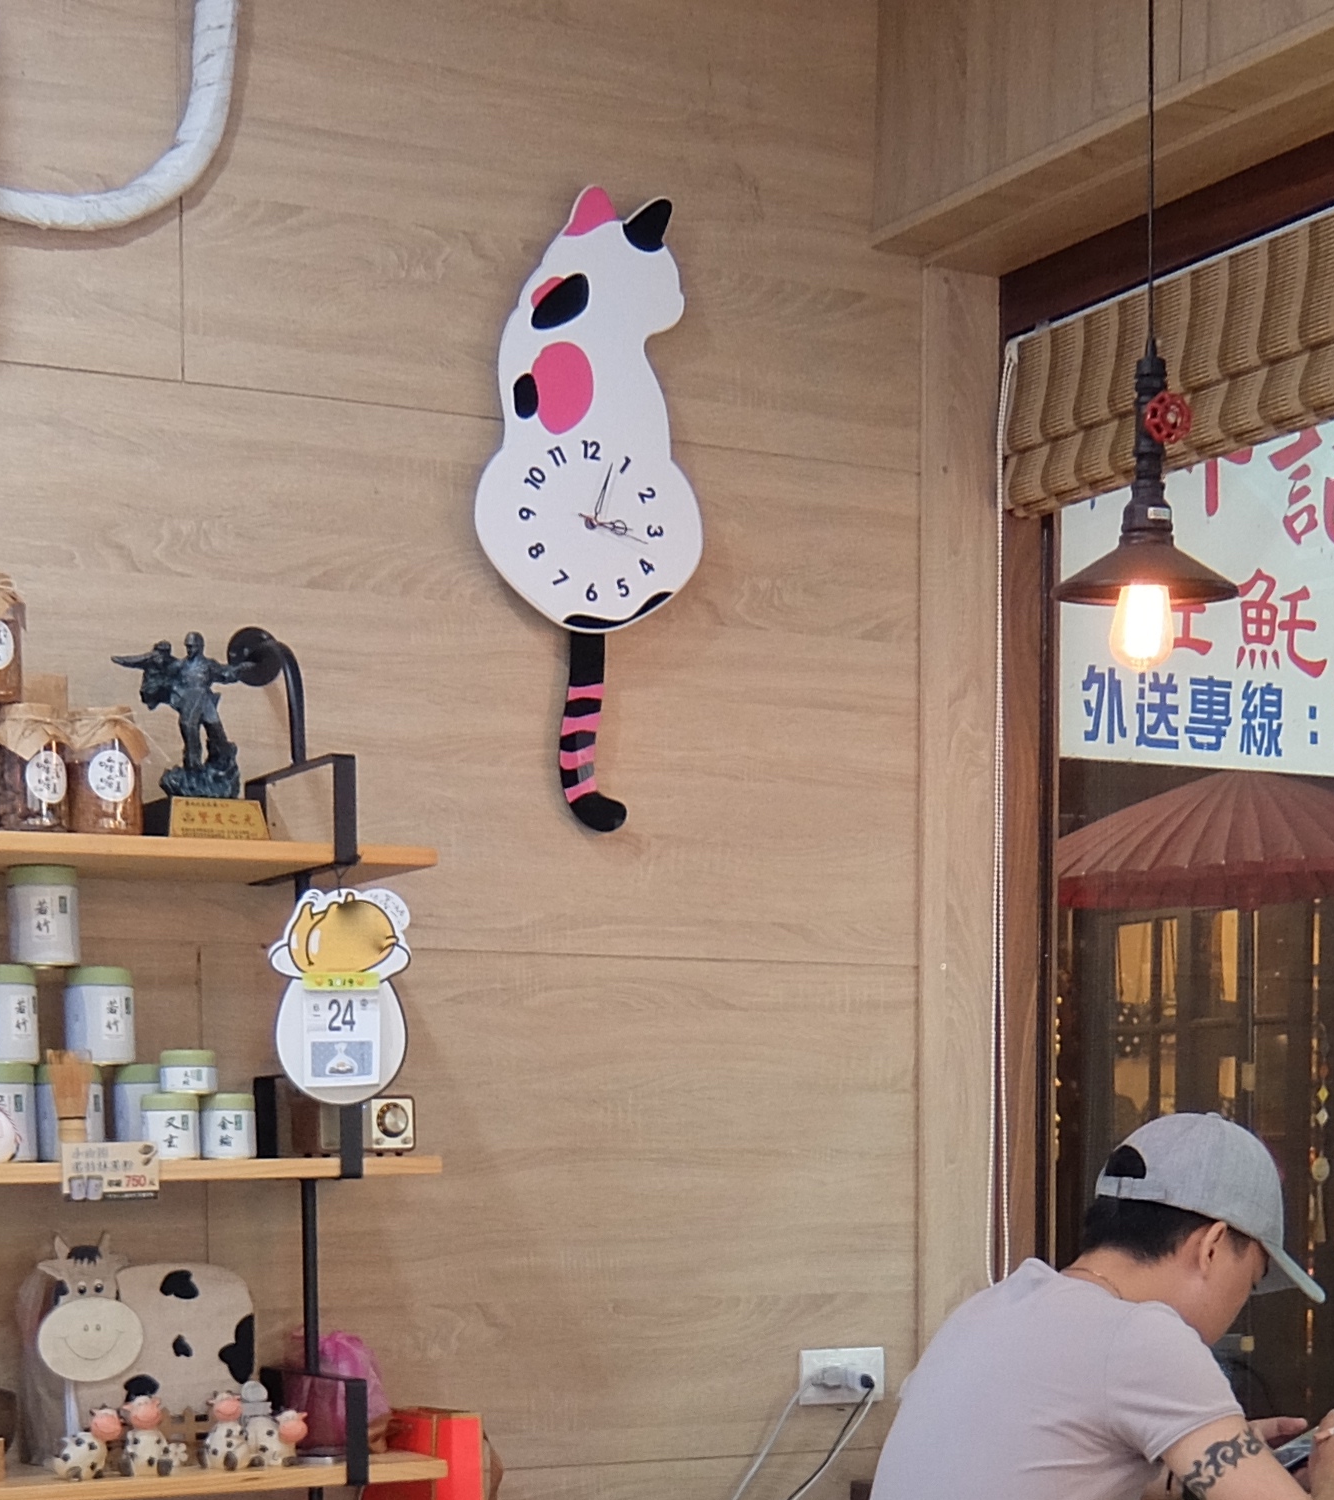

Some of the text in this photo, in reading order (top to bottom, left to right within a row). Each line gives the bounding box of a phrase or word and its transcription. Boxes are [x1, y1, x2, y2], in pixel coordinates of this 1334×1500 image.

[547, 446, 568, 467] 11
[581, 440, 601, 461] 12
[618, 456, 632, 473] 1
[524, 466, 546, 490] 10
[638, 487, 656, 503] 2
[518, 506, 536, 521] 9
[646, 524, 664, 540] 3
[528, 543, 545, 559] 8
[639, 558, 655, 575] 4
[552, 569, 569, 586] 7
[585, 583, 598, 602] 6
[617, 578, 630, 598] 5
[328, 999, 356, 1032] 24
[125, 1174, 147, 1188] 750
